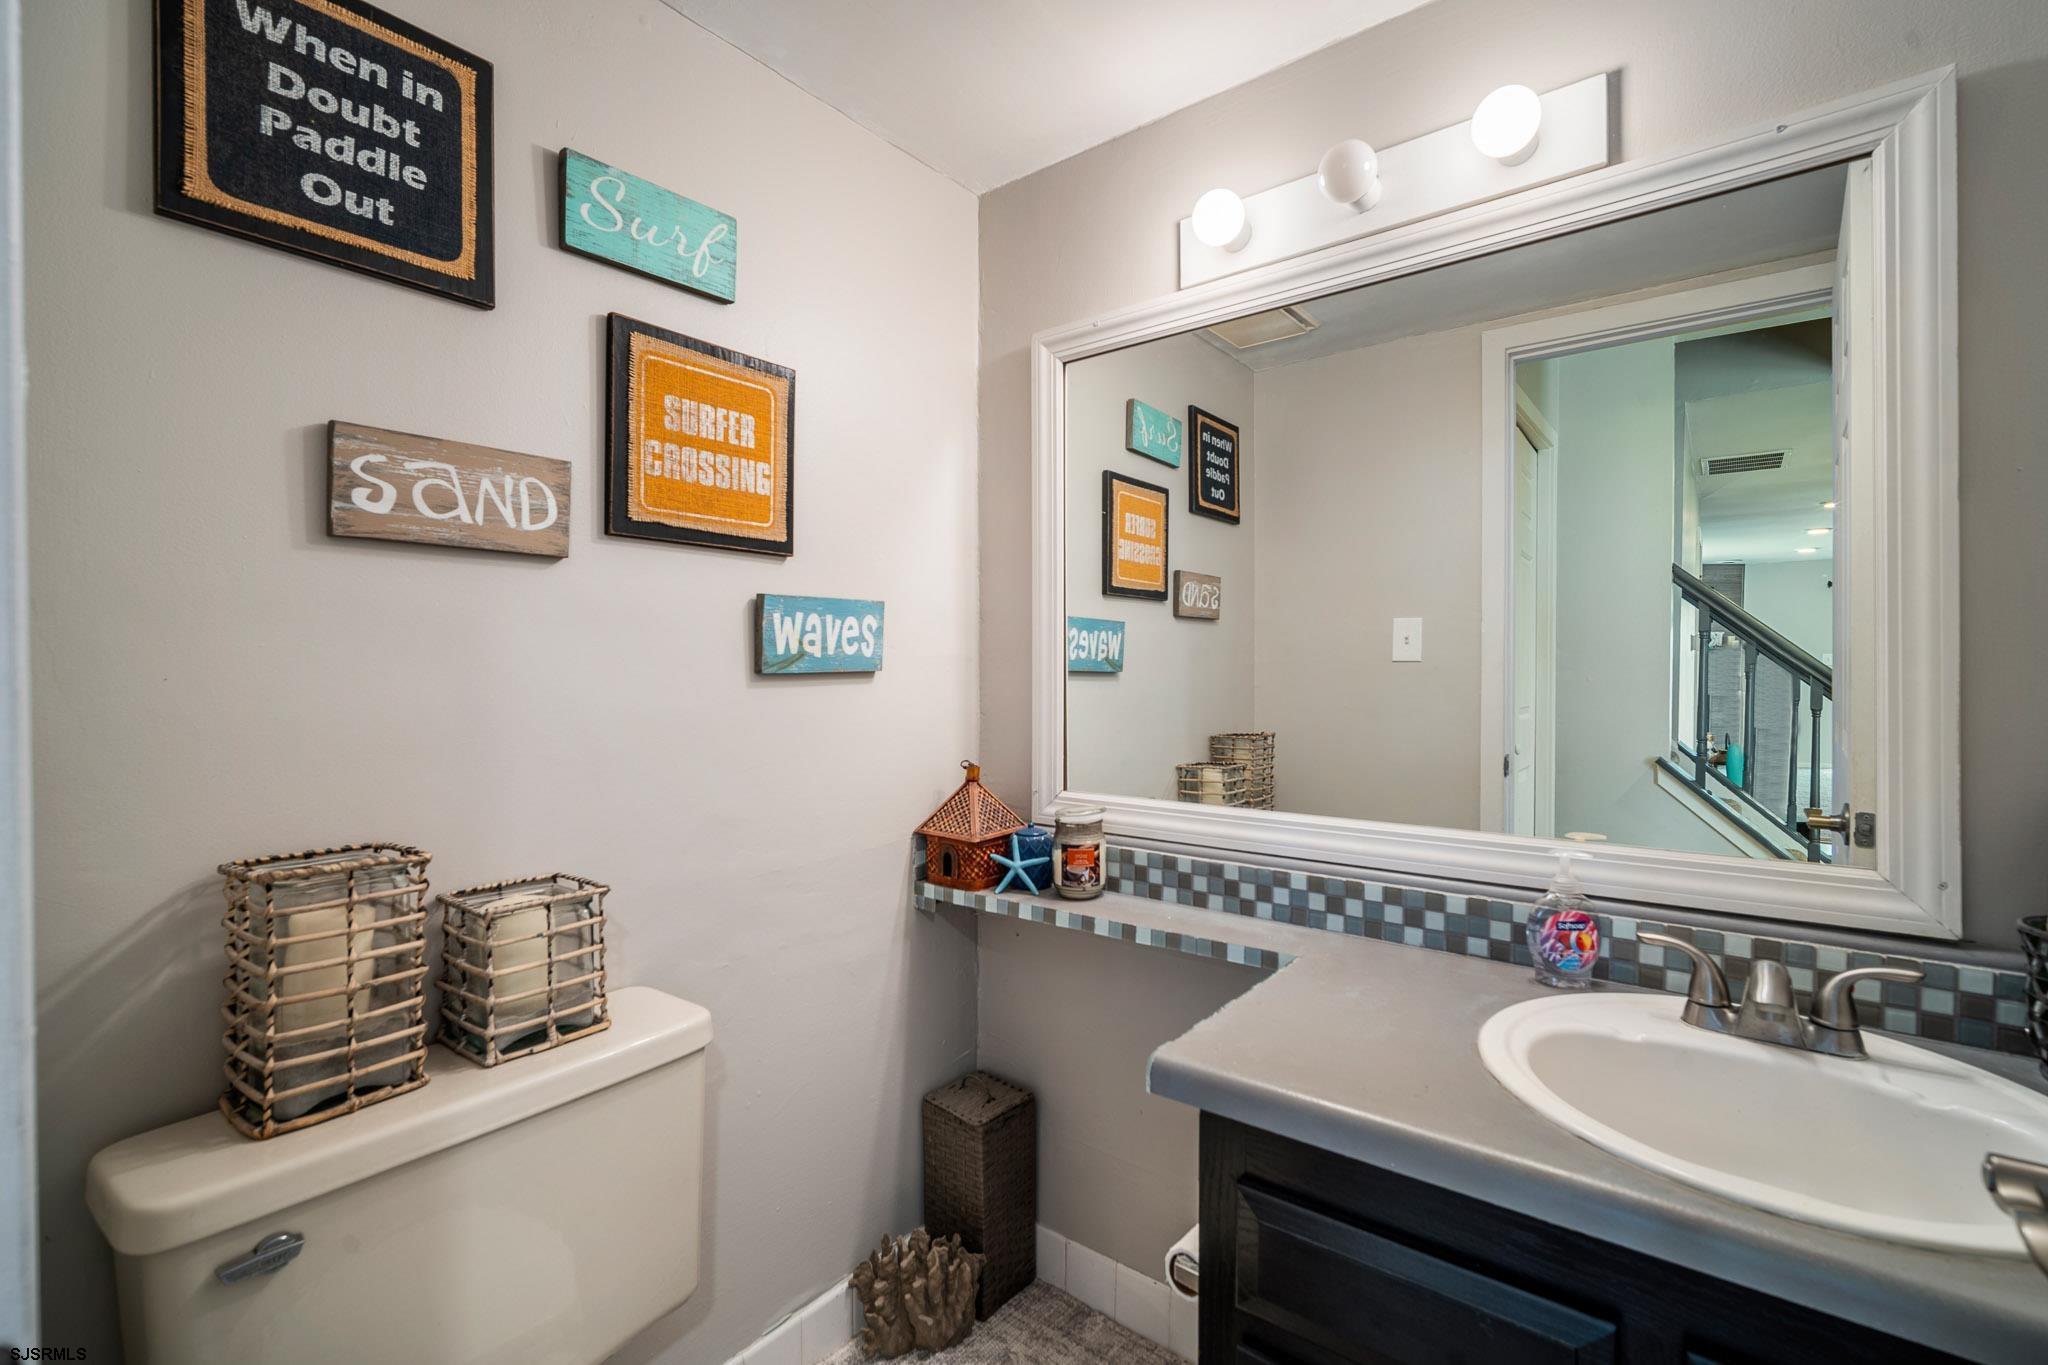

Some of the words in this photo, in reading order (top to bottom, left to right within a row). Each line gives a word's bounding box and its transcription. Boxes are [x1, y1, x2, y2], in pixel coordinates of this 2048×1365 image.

[235, 0, 388, 89] When
[401, 70, 444, 112] in
[259, 104, 428, 190] Paddle
[267, 61, 421, 148] Doubt
[300, 172, 395, 226] Out
[580, 175, 728, 278] Surf
[663, 394, 756, 449] SURFER
[643, 439, 771, 496] CROSSING
